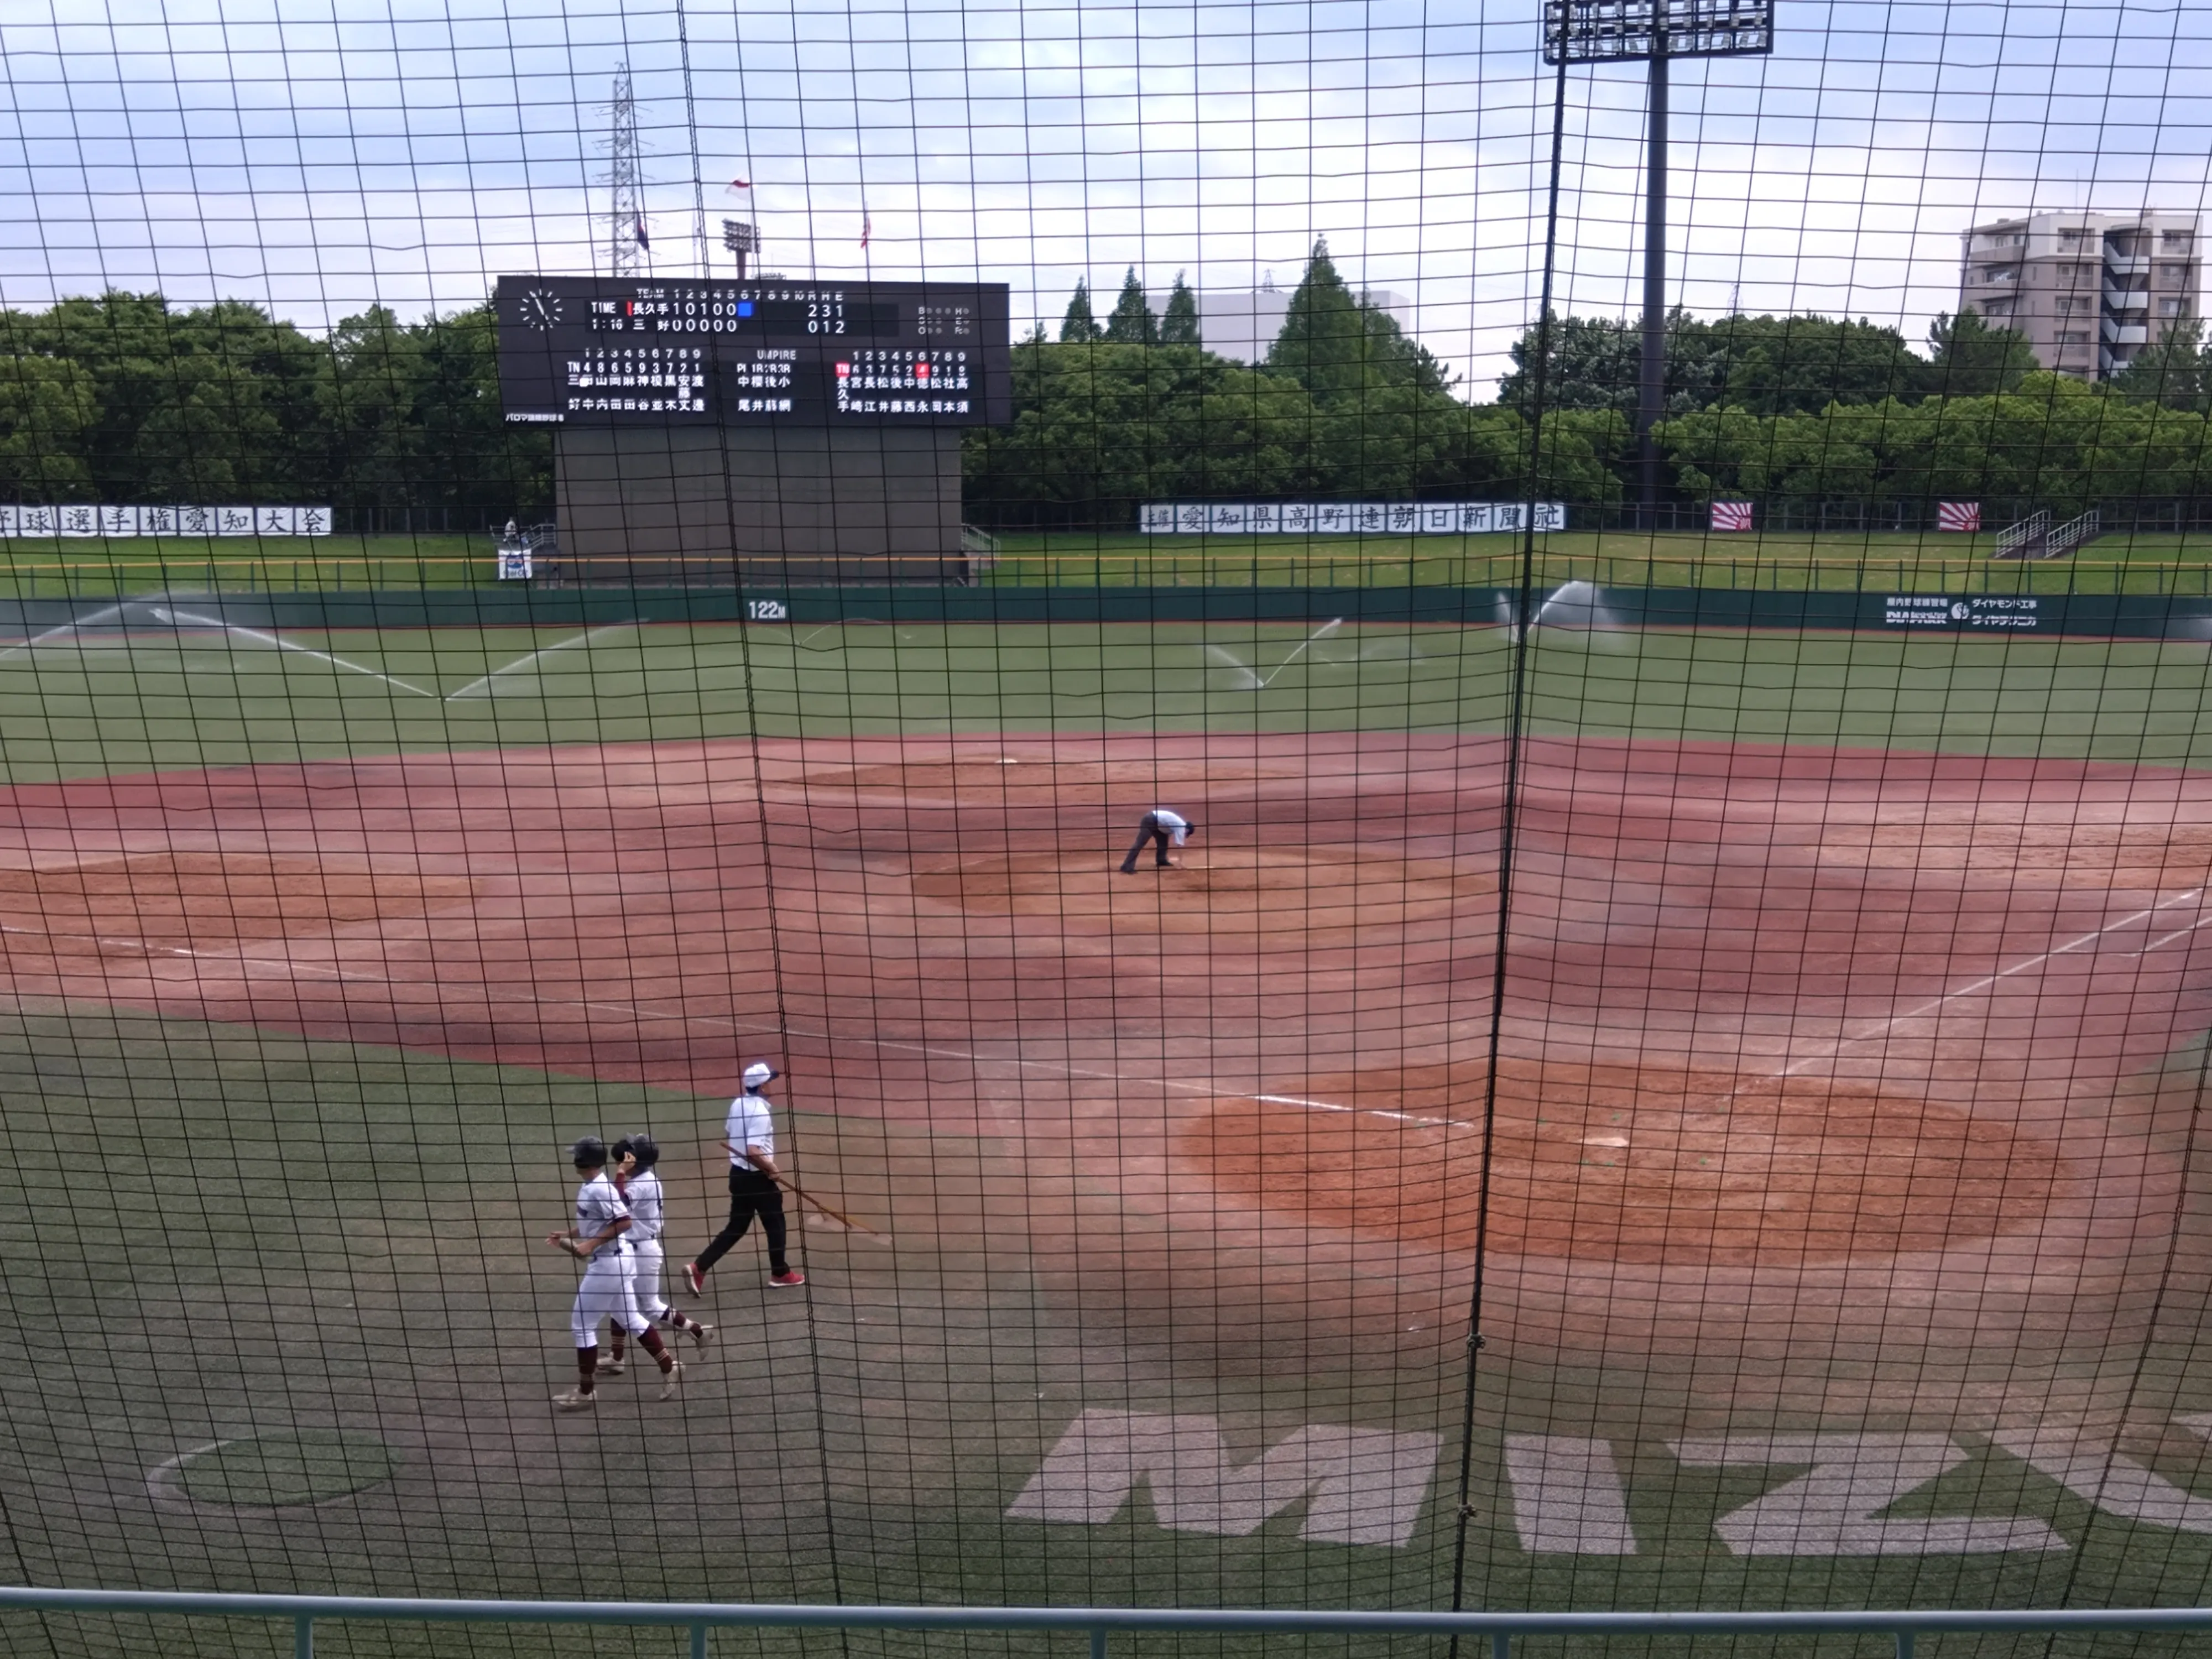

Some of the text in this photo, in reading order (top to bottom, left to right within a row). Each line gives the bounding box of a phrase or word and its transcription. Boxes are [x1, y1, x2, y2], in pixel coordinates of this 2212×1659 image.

[686, 289, 693, 299] 2
[713, 290, 721, 299] 4
[728, 290, 734, 299] 5
[741, 290, 748, 299] 6
[754, 290, 760, 299] 7
[836, 292, 842, 301] E
[592, 302, 615, 313] TIME
[633, 302, 842, 317] 長久手 1 0 1 0 0 2 3 1
[633, 319, 844, 333] 三好 0 0 0 0 0 0 1 2
[586, 348, 589, 357] 1
[597, 348, 603, 358] 2
[624, 349, 632, 358] 4
[639, 349, 645, 358] 5
[652, 349, 659, 358] 6
[666, 349, 673, 358] 7
[680, 349, 686, 358] 8
[693, 349, 700, 358] 9
[758, 350, 796, 359] UMPIRE
[853, 351, 965, 361] 1 2 3 4 5 6 7 8 9
[568, 362, 698, 373] TN 4 8 6 5 9 3 7 2 1
[837, 364, 849, 373] TN
[880, 365, 885, 373] 7
[568, 374, 580, 410] 三好
[637, 375, 649, 410] 神谷
[665, 375, 677, 410] 黒木
[837, 378, 849, 413] 長久手
[864, 378, 875, 413] 長江
[878, 378, 889, 413] 松井
[891, 378, 902, 413] 後藤
[904, 378, 915, 413] 中西
[1973, 599, 2037, 609] ダイヤモンド工事
